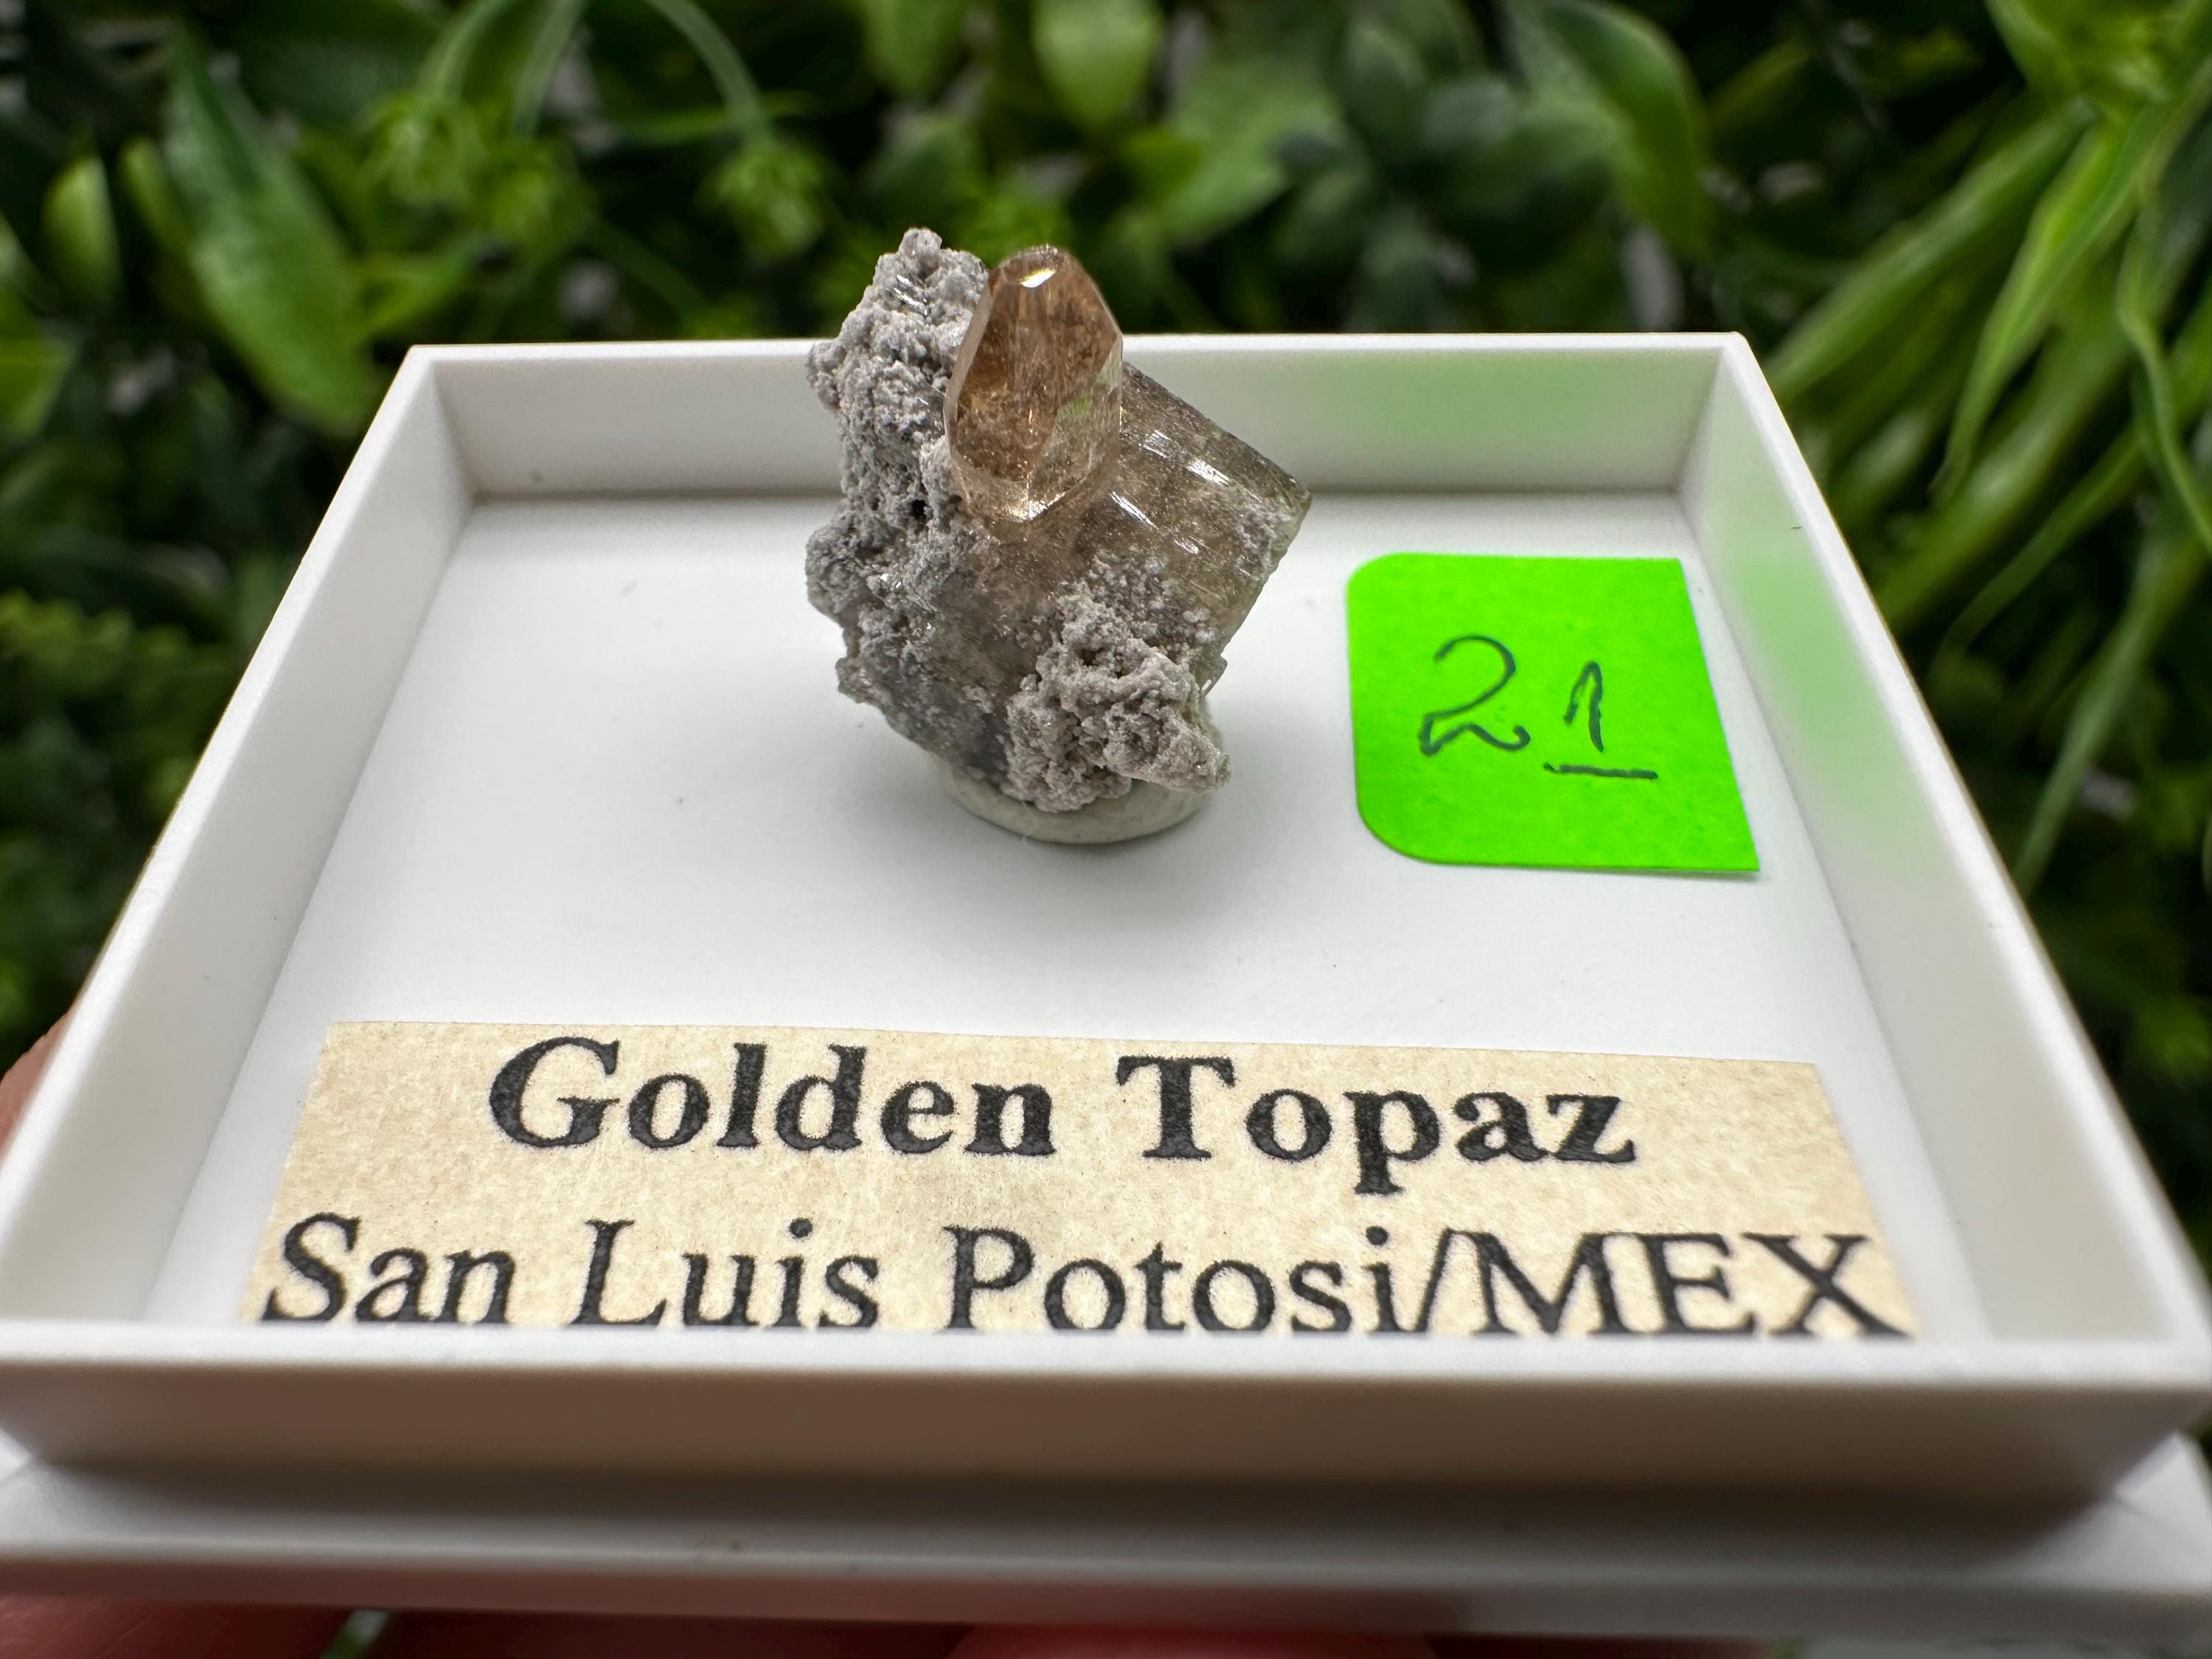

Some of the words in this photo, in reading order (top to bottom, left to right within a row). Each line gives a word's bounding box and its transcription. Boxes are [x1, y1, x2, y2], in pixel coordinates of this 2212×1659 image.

[1417, 633, 1658, 780] 21
[489, 1035, 1056, 1157] Golden
[1115, 1054, 1637, 1197] Topaz
[261, 1211, 516, 1324] San
[569, 1217, 879, 1329] Luis
[942, 1224, 1902, 1338] Potosi/MEX
